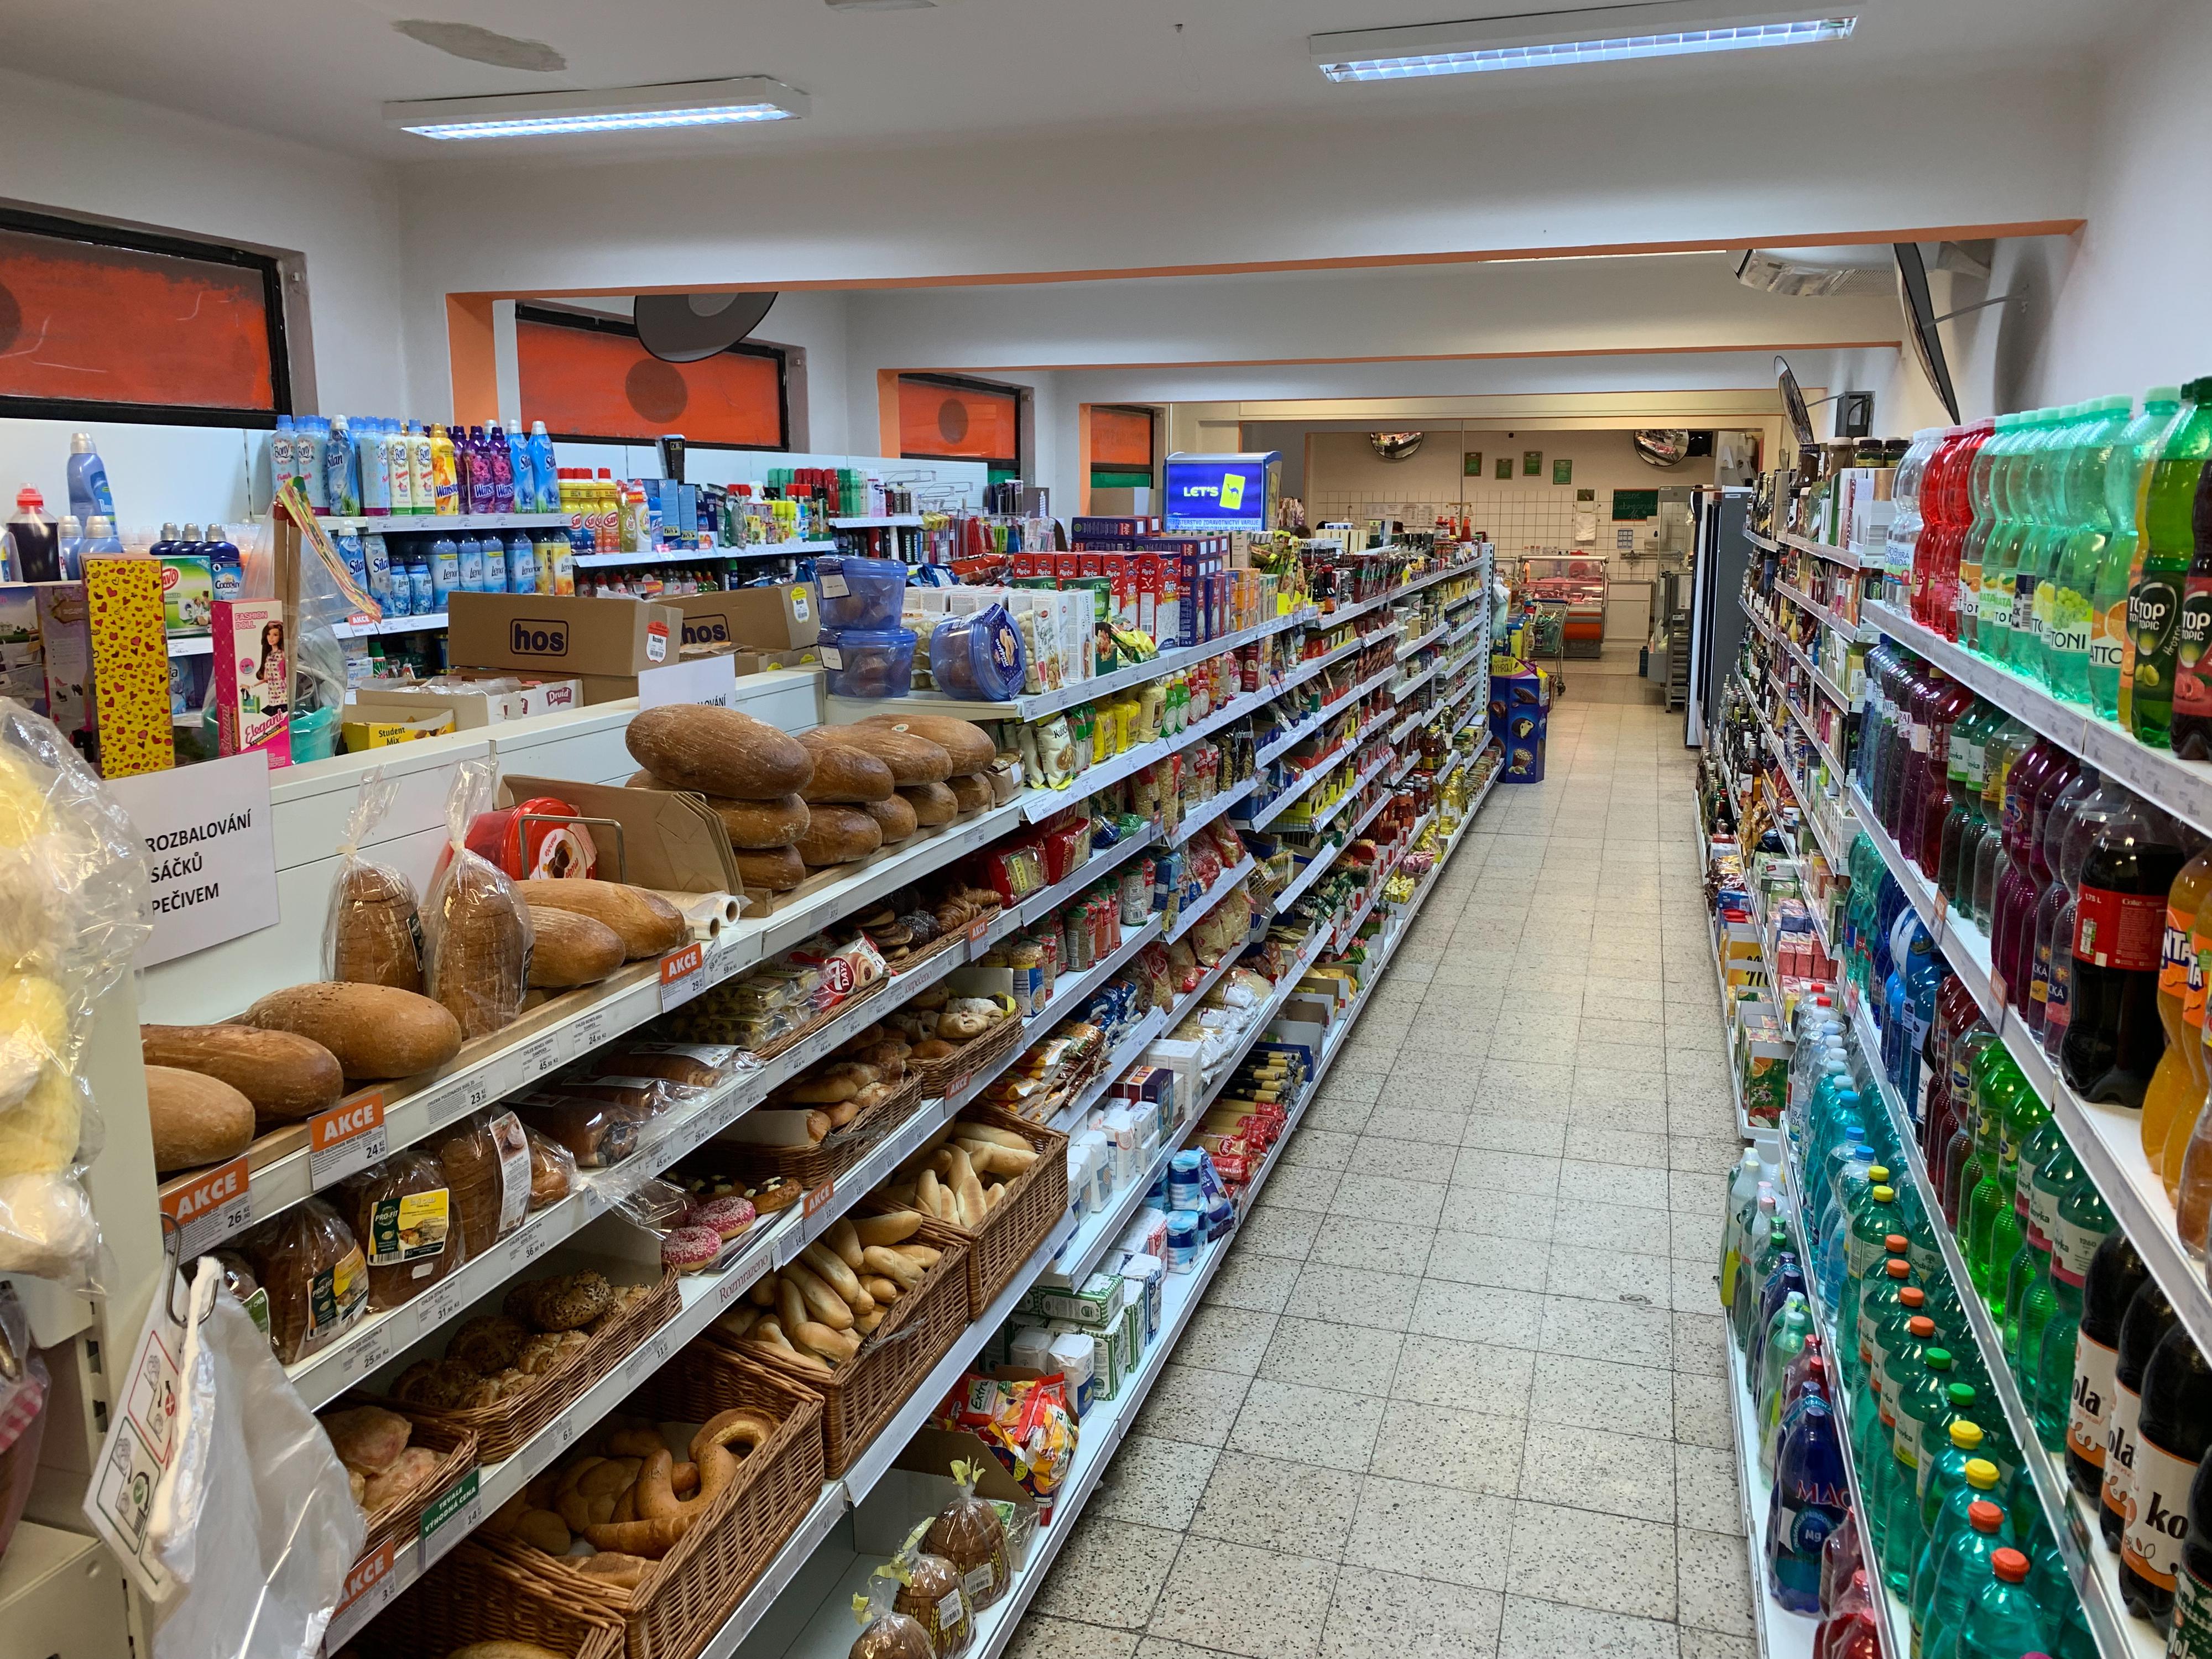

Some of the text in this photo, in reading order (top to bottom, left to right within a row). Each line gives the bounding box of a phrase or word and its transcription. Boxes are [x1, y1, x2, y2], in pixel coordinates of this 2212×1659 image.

[274, 444, 289, 458] Bony
[394, 448, 407, 460] Bony
[1183, 487, 1219, 497] LET'S
[470, 567, 482, 579] Leno
[215, 580, 242, 590] Coccolin
[235, 611, 268, 622] FASHION
[2138, 601, 2166, 620] TOP
[236, 620, 257, 630] DOLL
[2138, 619, 2160, 631] TOPIC
[2183, 611, 2211, 630] TOP
[514, 623, 565, 653] hos
[682, 623, 726, 644] hos
[2182, 629, 2205, 641] TOPIC
[548, 689, 570, 705] Druid
[245, 708, 284, 745] Elegant
[378, 726, 406, 738] Student
[387, 736, 400, 745] Mix
[145, 808, 252, 853] ROZBALOVÁNÍ
[150, 852, 203, 883] SÁČKŮ
[152, 883, 220, 916] PEČIVEM
[972, 924, 987, 939] AKCE
[668, 951, 698, 978] AKCE
[840, 960, 850, 987] DAYS
[904, 970, 932, 994] ozpečeno
[691, 980, 700, 992] 29
[950, 1077, 968, 1095] AKCE
[470, 1092, 481, 1105] 23
[324, 1104, 374, 1142] AKCE
[366, 1144, 379, 1159] 24
[176, 1171, 238, 1220] AKCE
[808, 1185, 830, 1212] AKCE
[227, 1210, 242, 1229] 26
[375, 1210, 399, 1222] PRO-FIT
[718, 1252, 769, 1303] Rozmrazeno
[312, 1278, 333, 1298] PRO-FIT
[970, 1379, 989, 1411] Extra
[562, 1430, 568, 1441] 6
[438, 1486, 463, 1511] TRVALE
[424, 1500, 458, 1533] VÝHODNÁ
[458, 1486, 477, 1504] CENA
[467, 1510, 477, 1525] 14
[1805, 1529, 1822, 1542] Mg
[382, 1589, 388, 1601] 3
